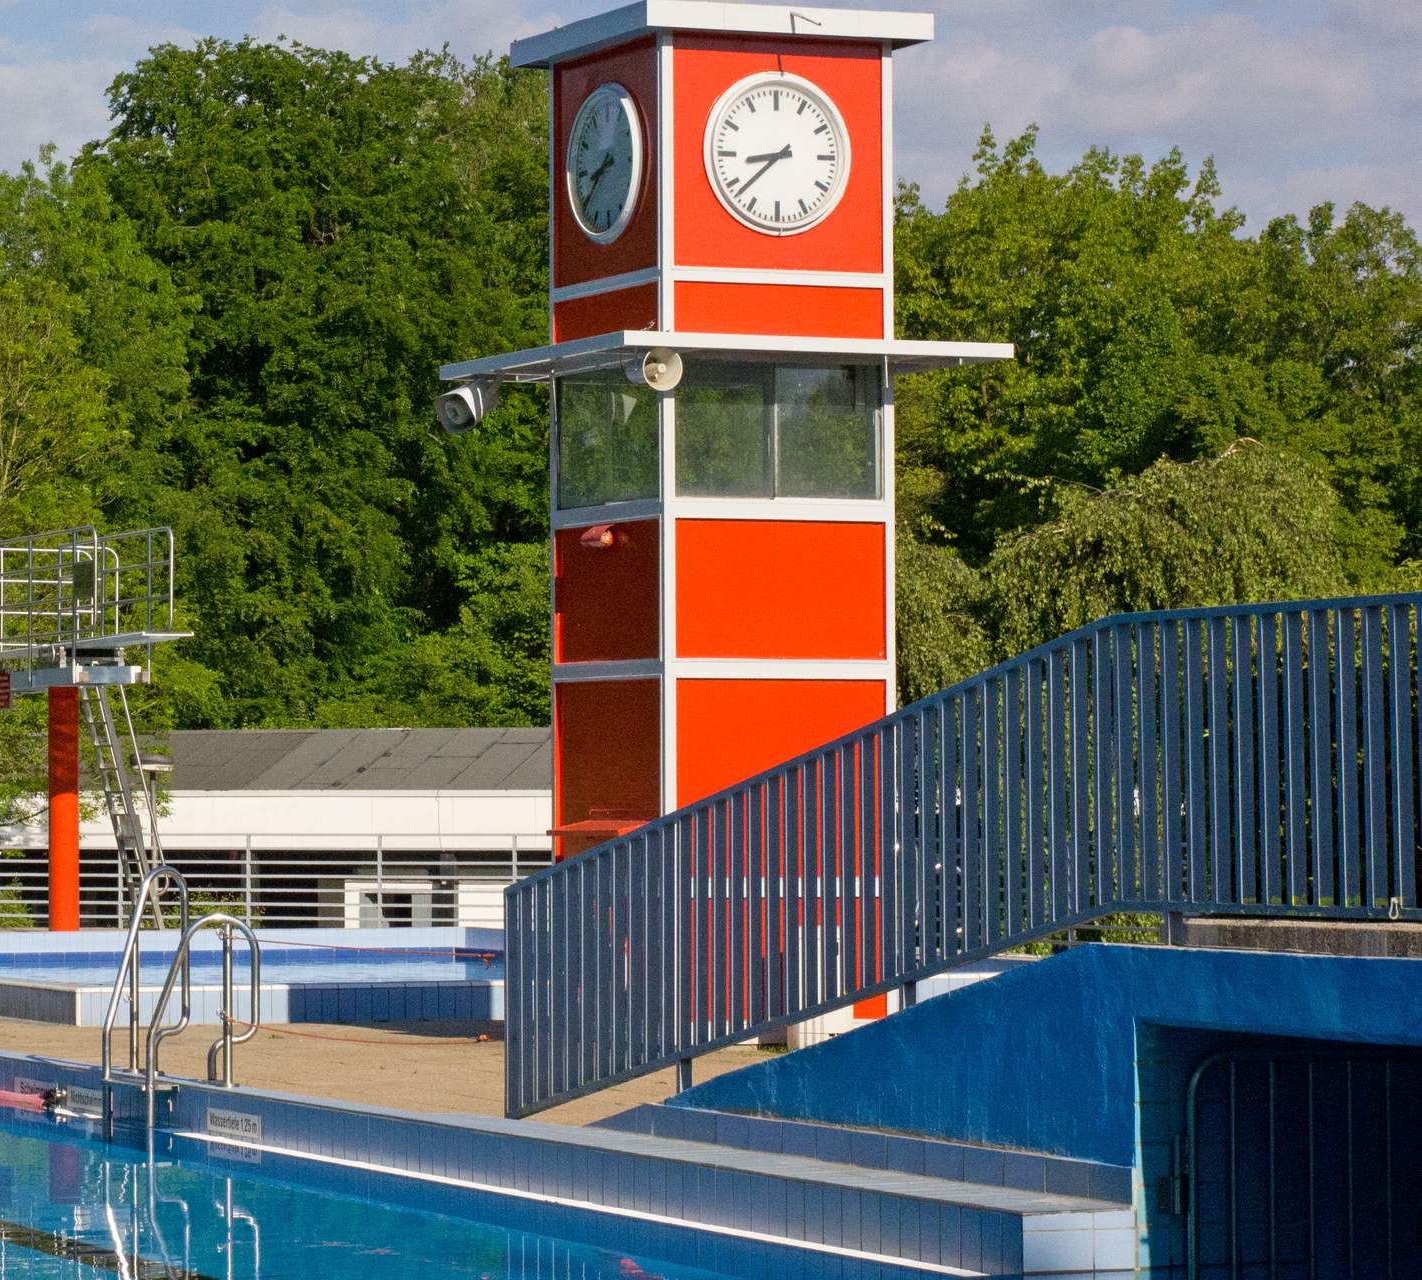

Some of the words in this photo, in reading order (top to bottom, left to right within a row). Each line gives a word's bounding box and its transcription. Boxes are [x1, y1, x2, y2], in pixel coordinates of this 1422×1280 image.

[209, 1112, 239, 1131] Wassertiefe
[240, 1118, 251, 1133] 1,25
[252, 1123, 257, 1133] m
